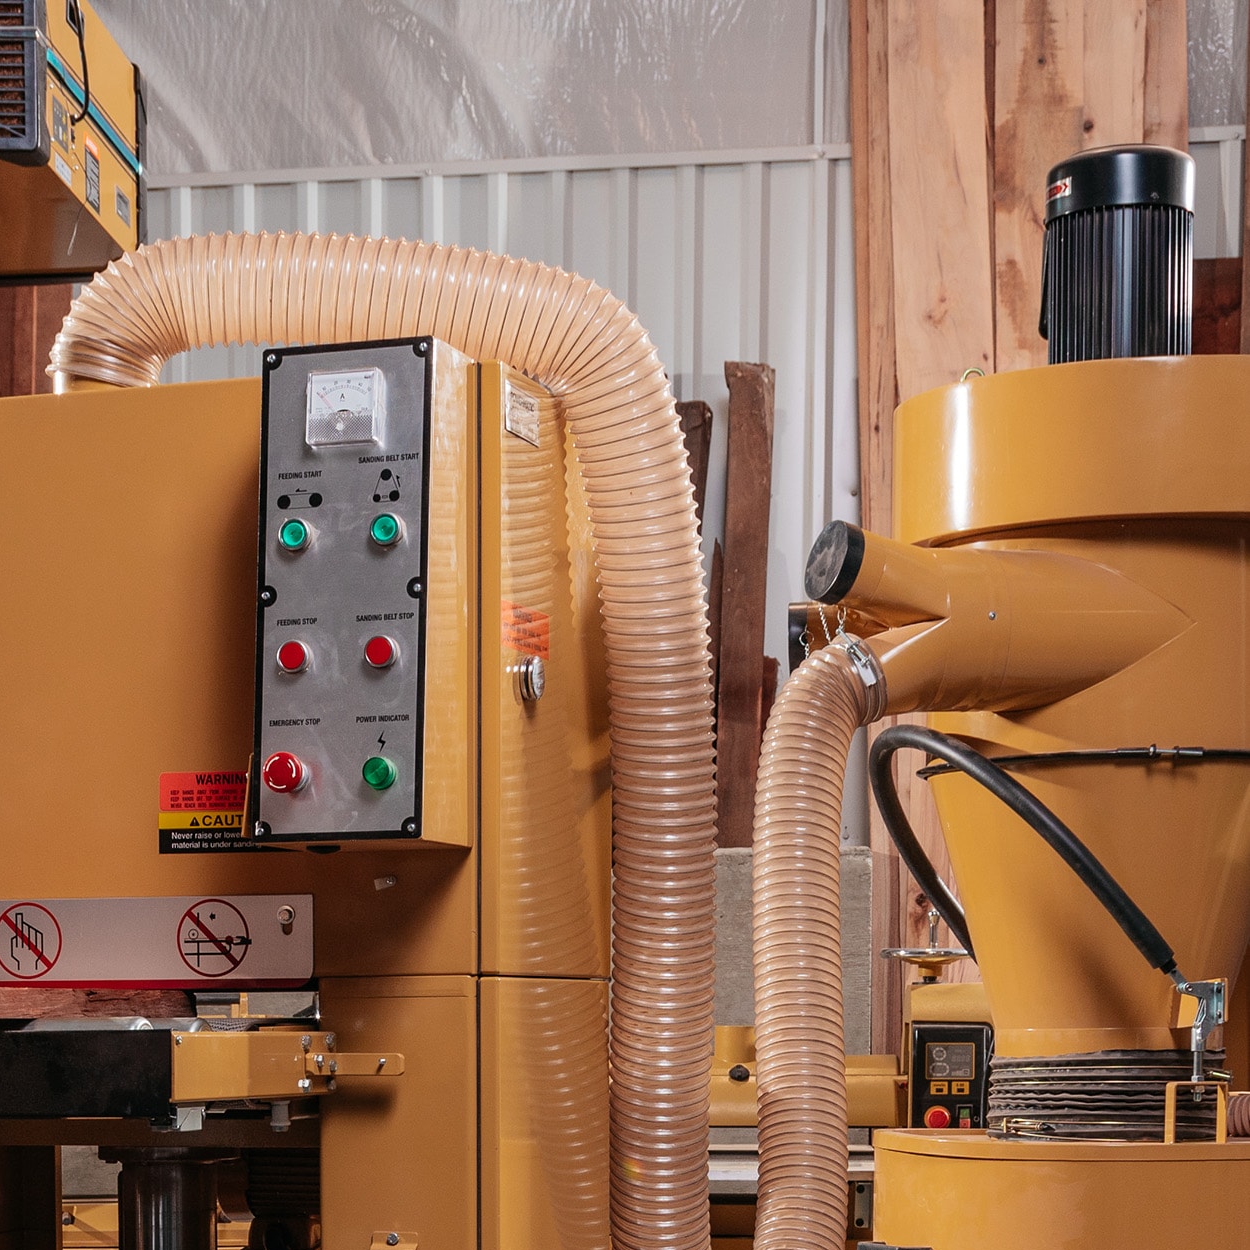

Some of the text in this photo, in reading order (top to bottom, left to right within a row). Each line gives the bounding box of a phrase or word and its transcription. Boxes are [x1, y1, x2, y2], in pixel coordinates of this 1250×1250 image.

[358, 456, 385, 464] SANDING
[385, 454, 400, 462] BELT
[278, 470, 323, 480] FEEDING START
[276, 617, 318, 627] FEEDING STOP
[355, 612, 415, 622] SANDING BELT STOP
[269, 718, 321, 727] EMERGENCY STOP
[355, 714, 410, 723] POWER INDICATOR
[195, 774, 247, 785] WARNIN
[202, 815, 243, 826] CAUT
[171, 831, 193, 840] Never
[194, 831, 213, 839] raise
[223, 831, 242, 839] lowe
[171, 841, 200, 849] material
